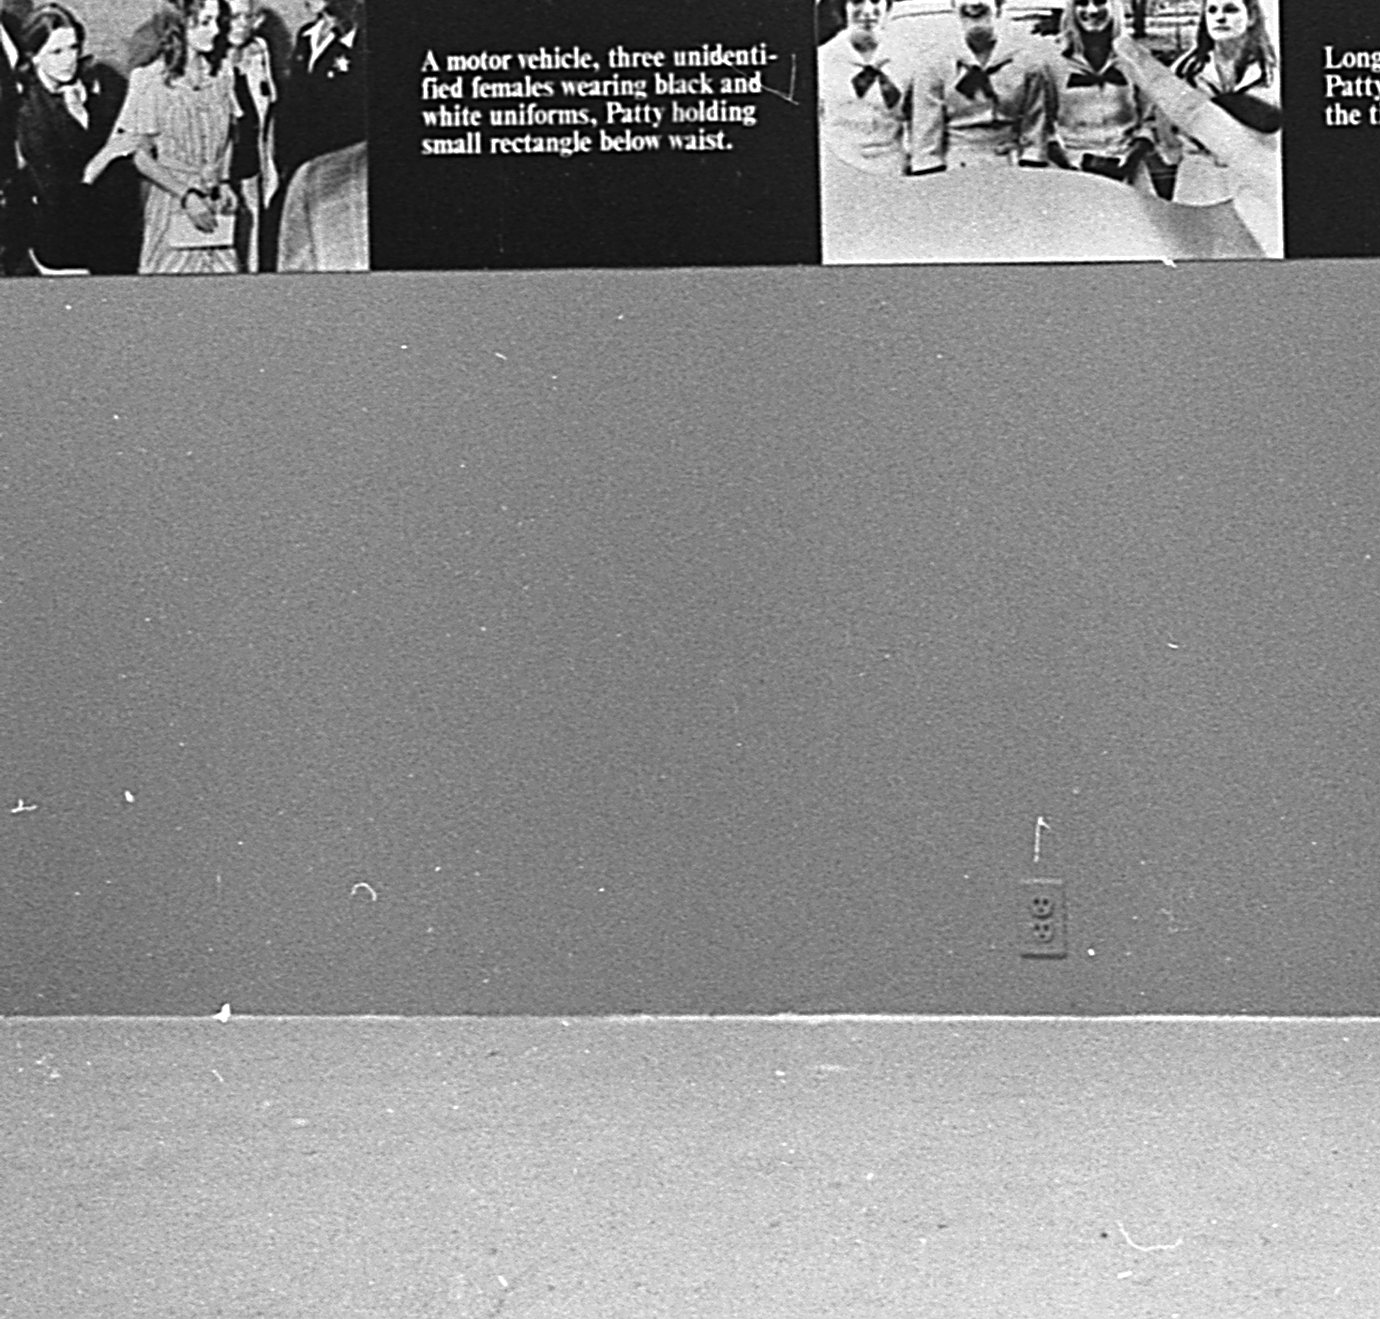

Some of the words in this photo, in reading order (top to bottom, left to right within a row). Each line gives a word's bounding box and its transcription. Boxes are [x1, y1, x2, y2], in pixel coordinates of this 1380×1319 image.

[422, 50, 439, 72] A
[447, 51, 512, 71] motor
[518, 46, 599, 70] vehicle,
[609, 46, 665, 68] three
[674, 43, 777, 66] unidenti-
[422, 76, 463, 99] fied
[472, 75, 554, 98] females
[561, 73, 647, 99] wearing
[655, 72, 713, 94] black
[721, 71, 762, 93] and
[423, 104, 482, 126] white
[490, 103, 597, 126] uniforms,
[607, 102, 664, 128] Patty
[673, 100, 756, 126] holding
[1326, 103, 1361, 125] the
[422, 132, 481, 154] small
[491, 130, 592, 156] rectangle
[600, 129, 659, 151] below
[669, 128, 732, 150] waist.
